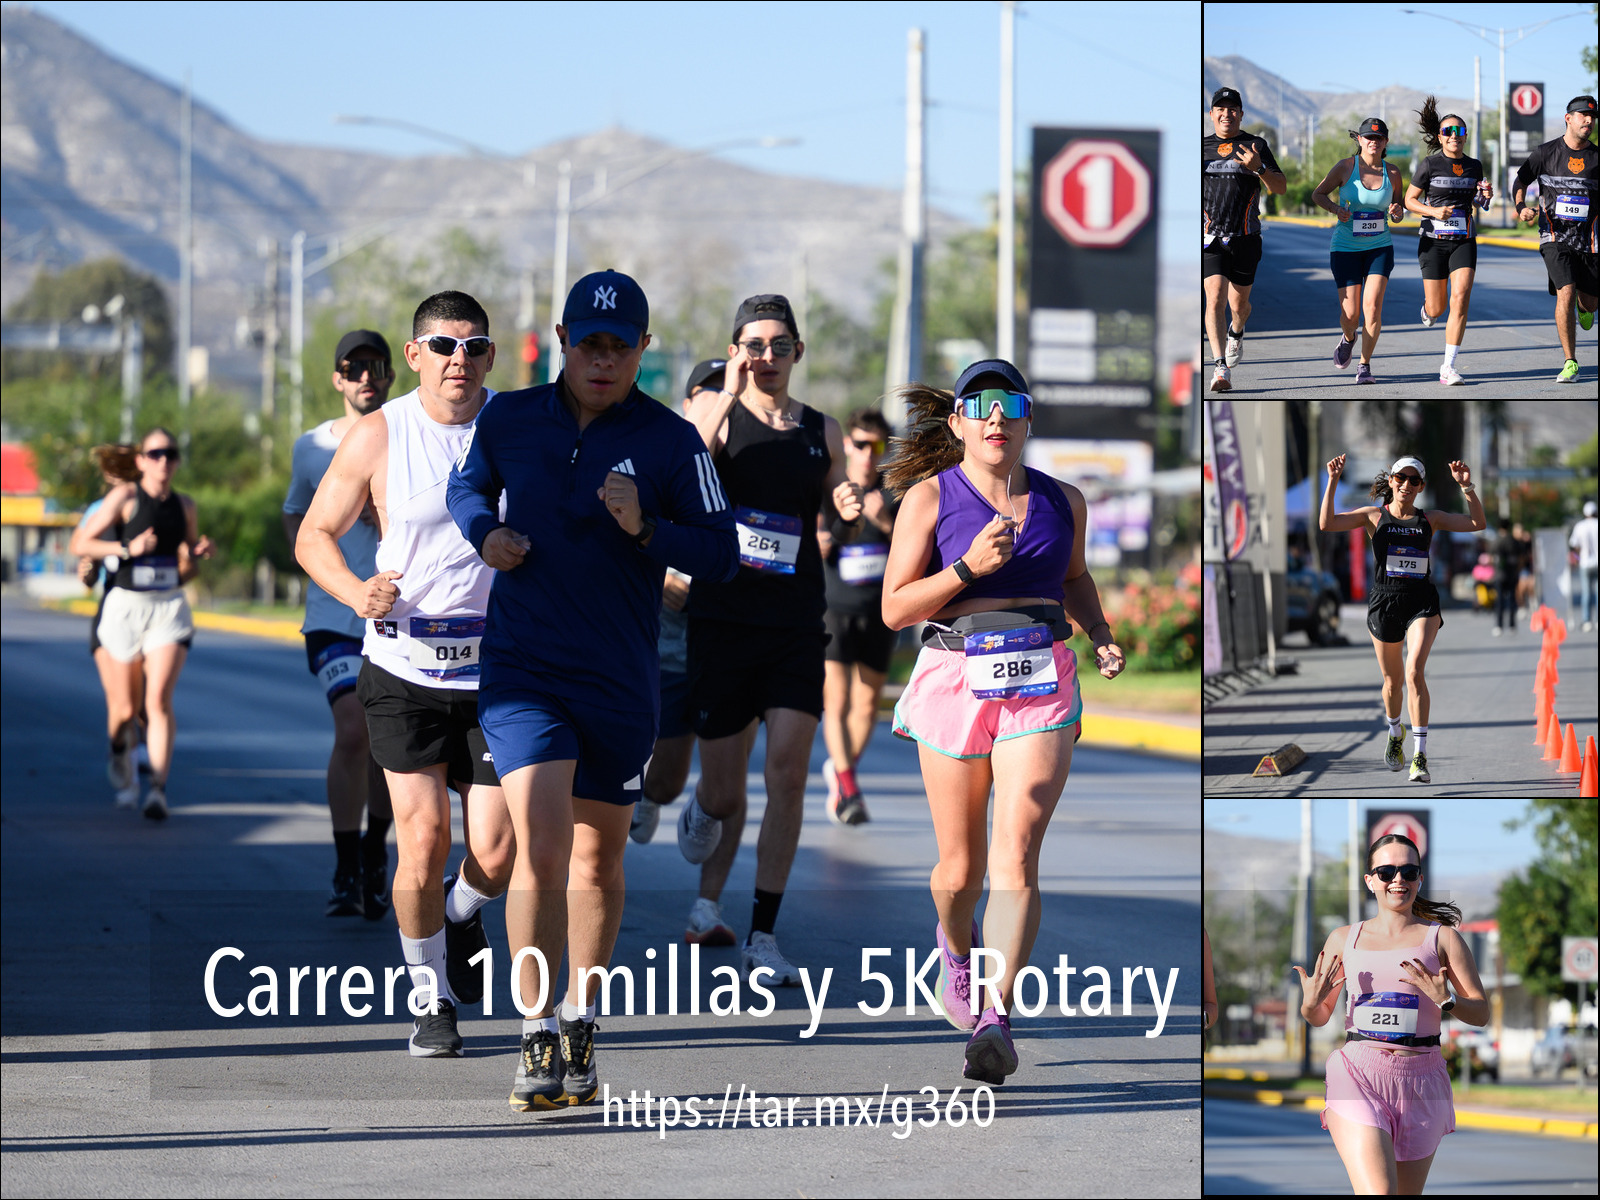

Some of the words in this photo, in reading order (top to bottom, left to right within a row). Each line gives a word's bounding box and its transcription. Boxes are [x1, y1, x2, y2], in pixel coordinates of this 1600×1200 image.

[1077, 155, 1114, 230] 1
[1564, 206, 1580, 214] 149
[1361, 222, 1378, 230] 230
[593, 285, 618, 310] NY
[1387, 526, 1423, 535] JANETH
[747, 535, 781, 553] 264
[1398, 560, 1417, 569] 175
[435, 645, 473, 661] 014
[992, 659, 1033, 679] 286
[1371, 1013, 1400, 1026] 221
